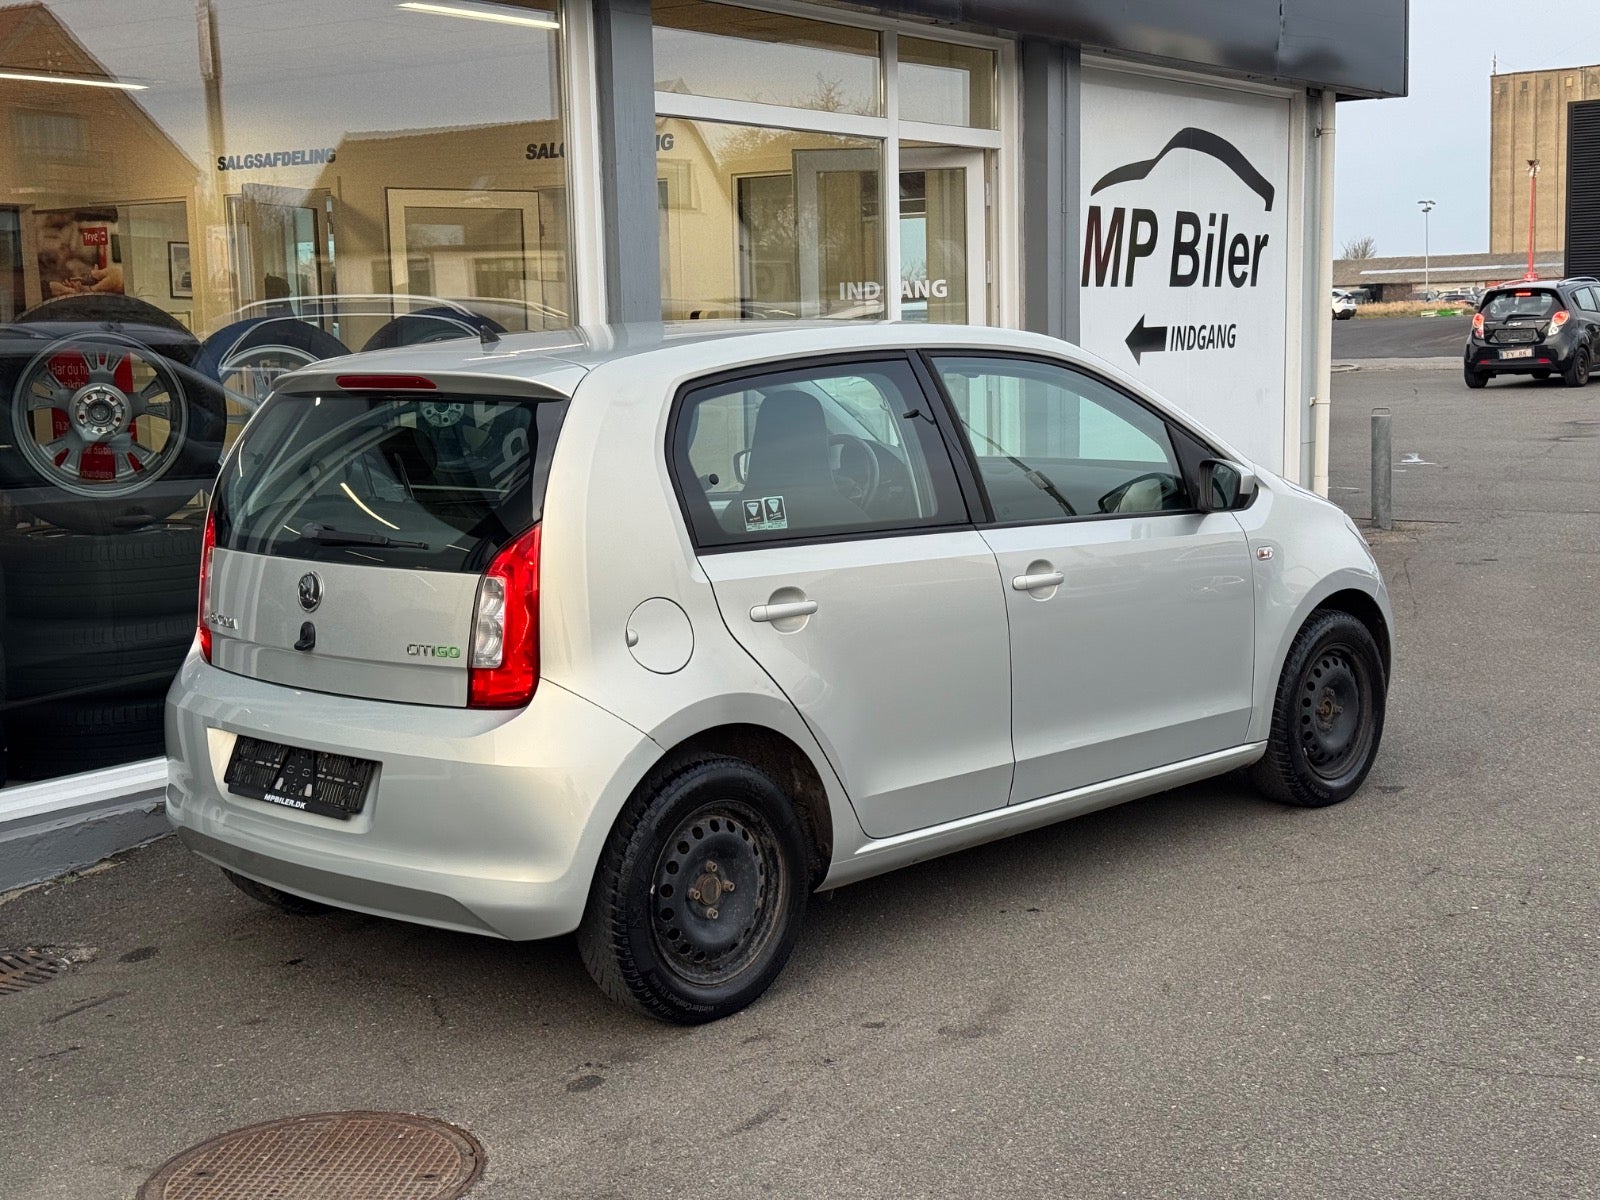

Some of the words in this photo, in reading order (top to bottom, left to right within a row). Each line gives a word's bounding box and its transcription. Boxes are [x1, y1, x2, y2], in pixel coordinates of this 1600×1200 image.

[217, 148, 336, 171] SALGSAFDELING
[1081, 205, 1159, 287] MP
[1169, 210, 1269, 288] Biler
[839, 279, 948, 300] INDANG
[1170, 323, 1237, 352] INDGANG
[51, 361, 66, 375] Har
[67, 362, 78, 375] du
[263, 793, 307, 810] MPBILER.DK
